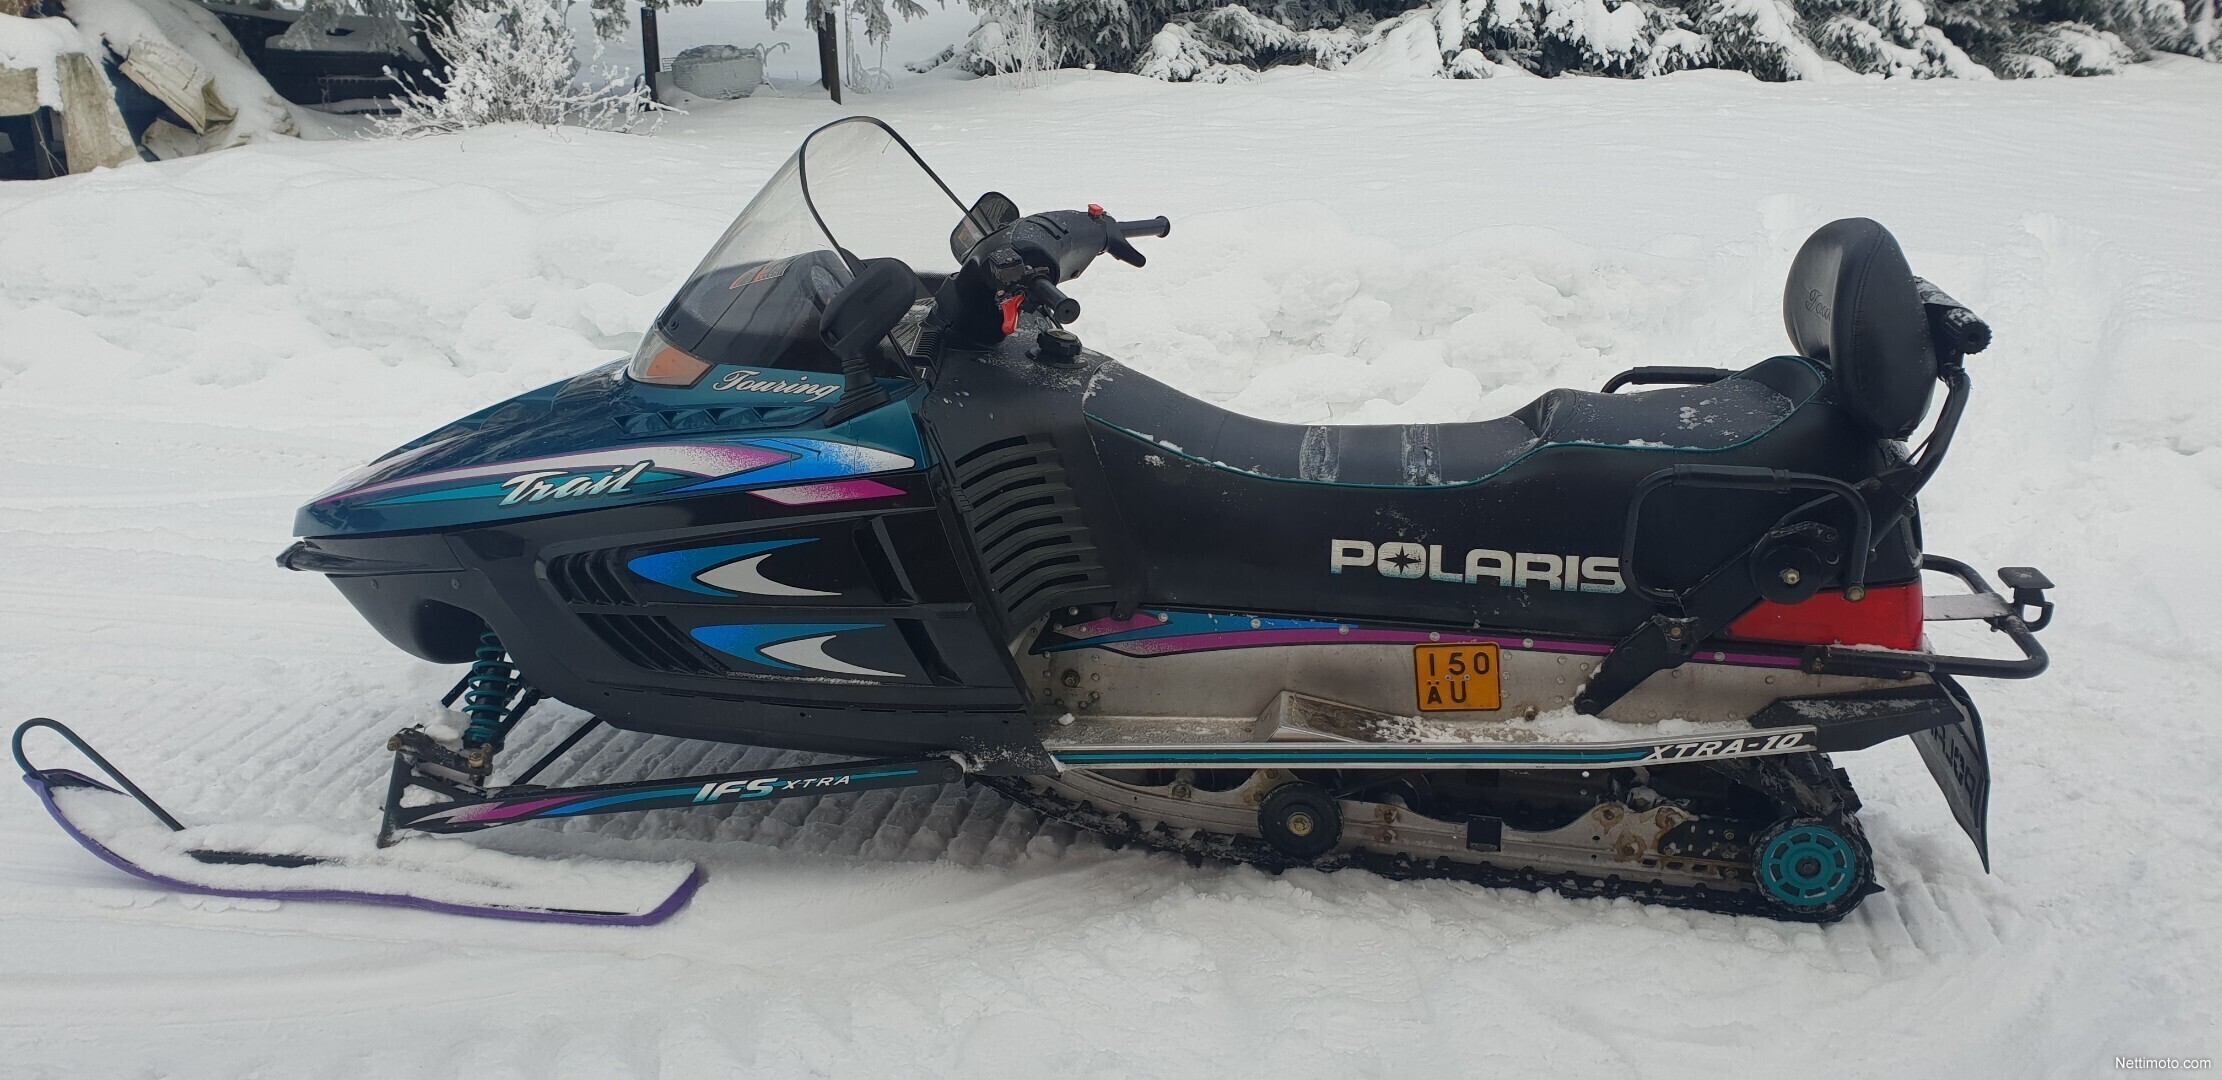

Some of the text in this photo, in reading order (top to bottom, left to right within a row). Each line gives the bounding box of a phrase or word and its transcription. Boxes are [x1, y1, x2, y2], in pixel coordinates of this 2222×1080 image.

[712, 370, 841, 403] Touring
[499, 460, 654, 507] Trail
[1330, 539, 1627, 594] POLARIS
[1429, 651, 1490, 676] 150
[1427, 680, 1467, 704] ÄU
[1641, 733, 1803, 761] XTRA-10
[693, 775, 850, 803] IFS XTRA
